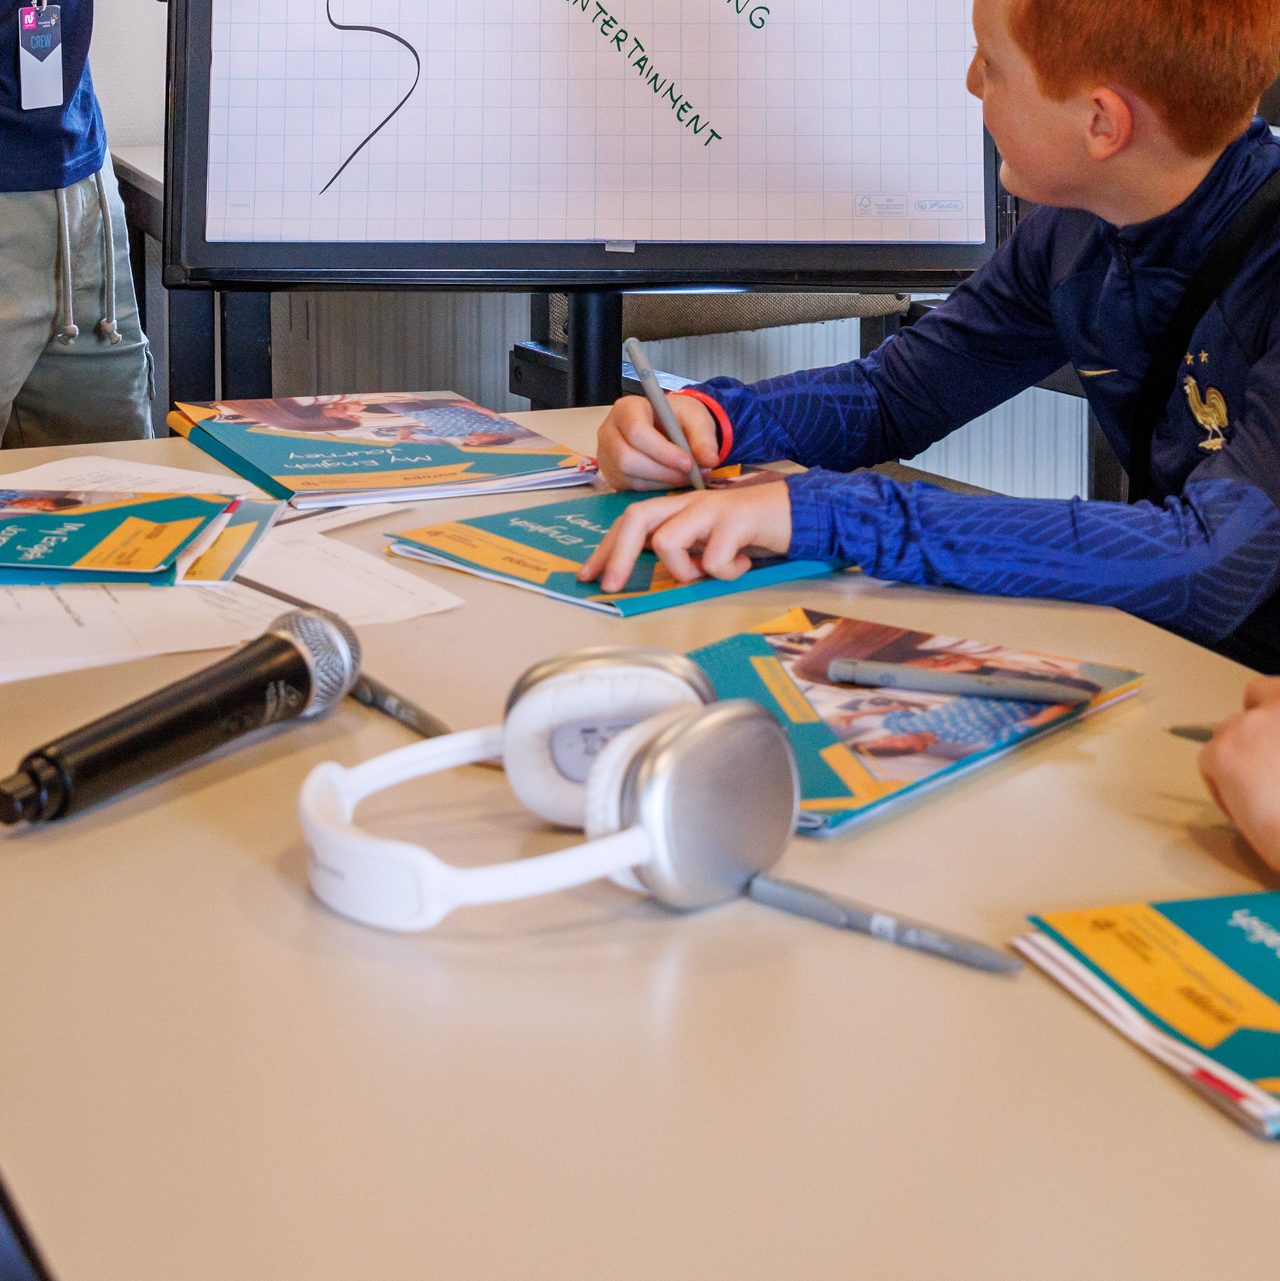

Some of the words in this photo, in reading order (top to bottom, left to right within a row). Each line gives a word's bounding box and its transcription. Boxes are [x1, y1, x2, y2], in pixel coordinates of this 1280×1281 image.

[30, 33, 52, 49] CREW
[288, 447, 403, 461] Journey
[389, 453, 433, 464] My
[282, 458, 380, 470] English
[508, 517, 584, 546] English
